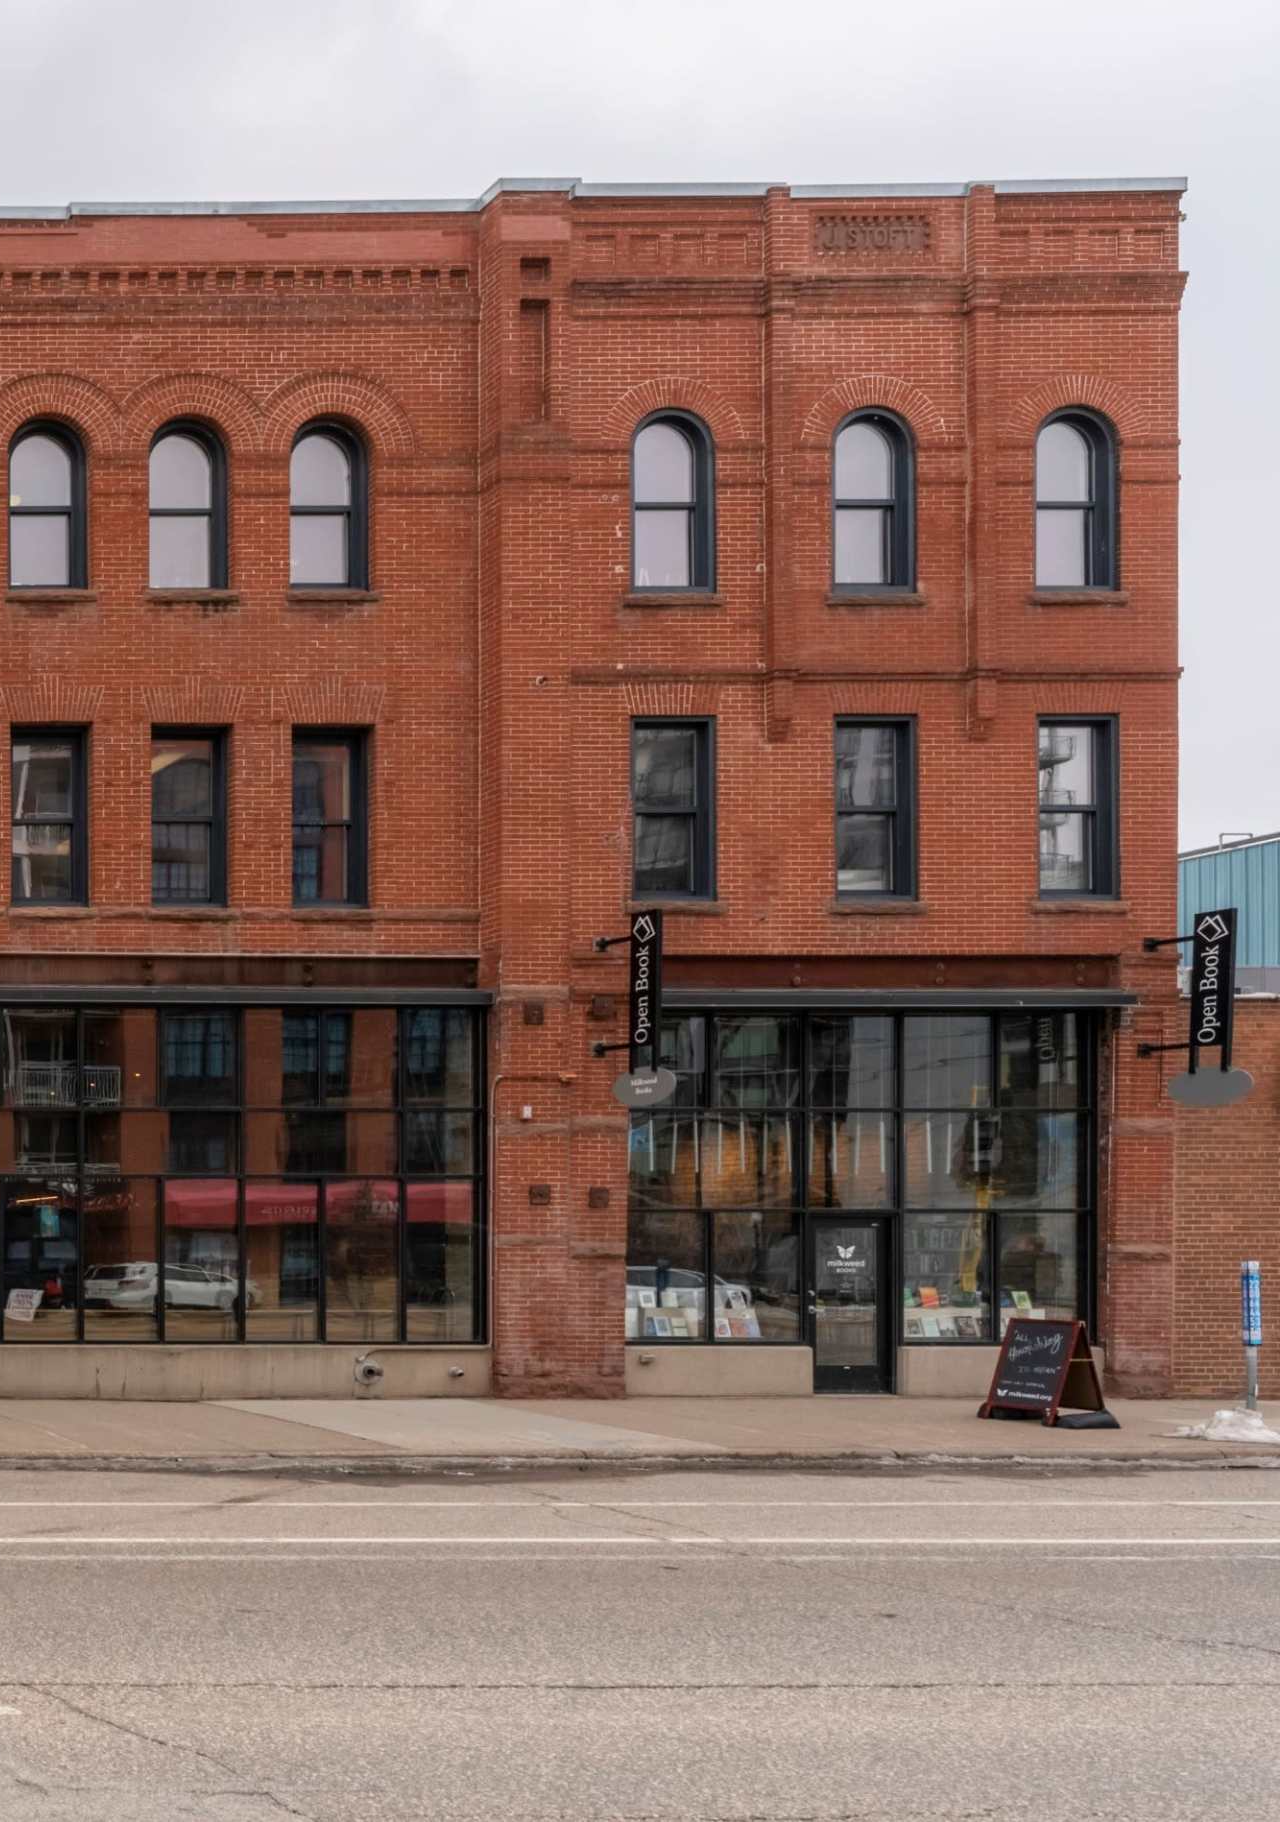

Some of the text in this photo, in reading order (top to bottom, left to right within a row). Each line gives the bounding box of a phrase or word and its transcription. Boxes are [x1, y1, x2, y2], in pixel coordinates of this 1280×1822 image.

[634, 946, 651, 1043] Open Book
[1197, 945, 1221, 1043] Open Book
